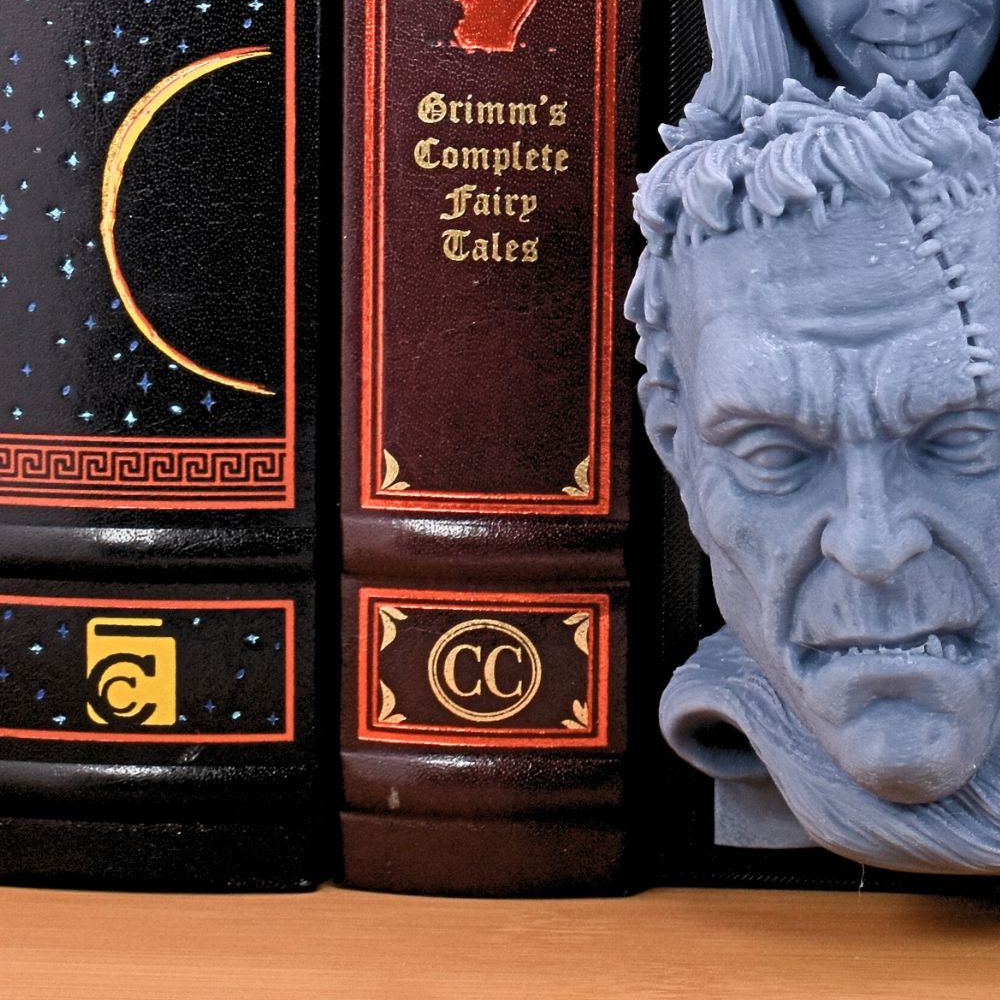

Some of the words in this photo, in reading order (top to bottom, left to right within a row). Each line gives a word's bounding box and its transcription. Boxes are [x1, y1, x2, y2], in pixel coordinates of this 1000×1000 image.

[417, 91, 568, 127] Grimm's
[413, 137, 570, 176] Complete
[439, 183, 538, 223] Fairy
[441, 229, 539, 262] Tales
